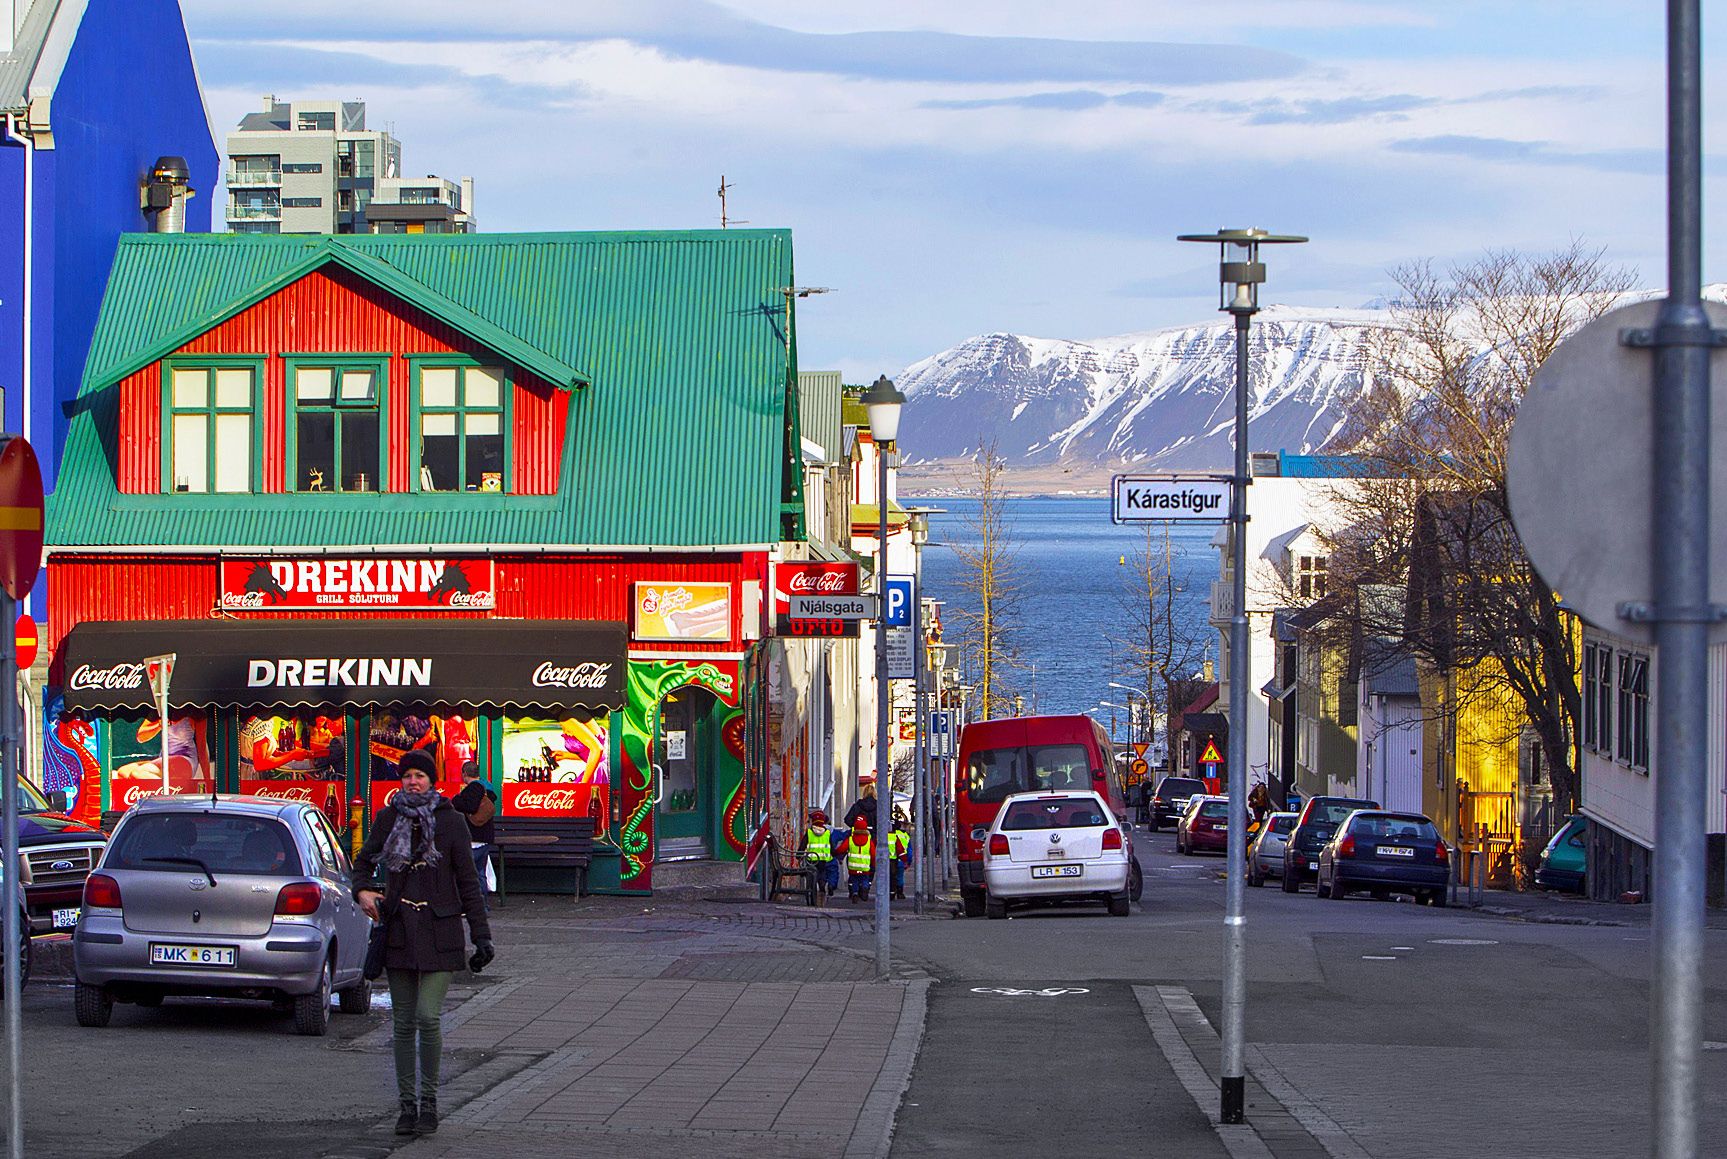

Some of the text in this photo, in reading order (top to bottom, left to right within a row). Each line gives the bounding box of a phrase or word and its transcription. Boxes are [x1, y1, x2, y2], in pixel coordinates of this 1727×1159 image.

[1126, 488, 1222, 514] Kárastígur
[270, 560, 446, 593] DREKINN
[790, 571, 848, 591] Coca-Cola
[316, 594, 344, 604] GRILL
[800, 600, 864, 615] Njálsgata
[70, 663, 147, 690] Coca-Cola
[247, 658, 433, 687] DREKINN
[532, 661, 613, 688] Coca-Cola
[514, 789, 576, 809] Coca-Cola
[1039, 867, 1078, 876] LR 153
[163, 947, 233, 963] MK 611
